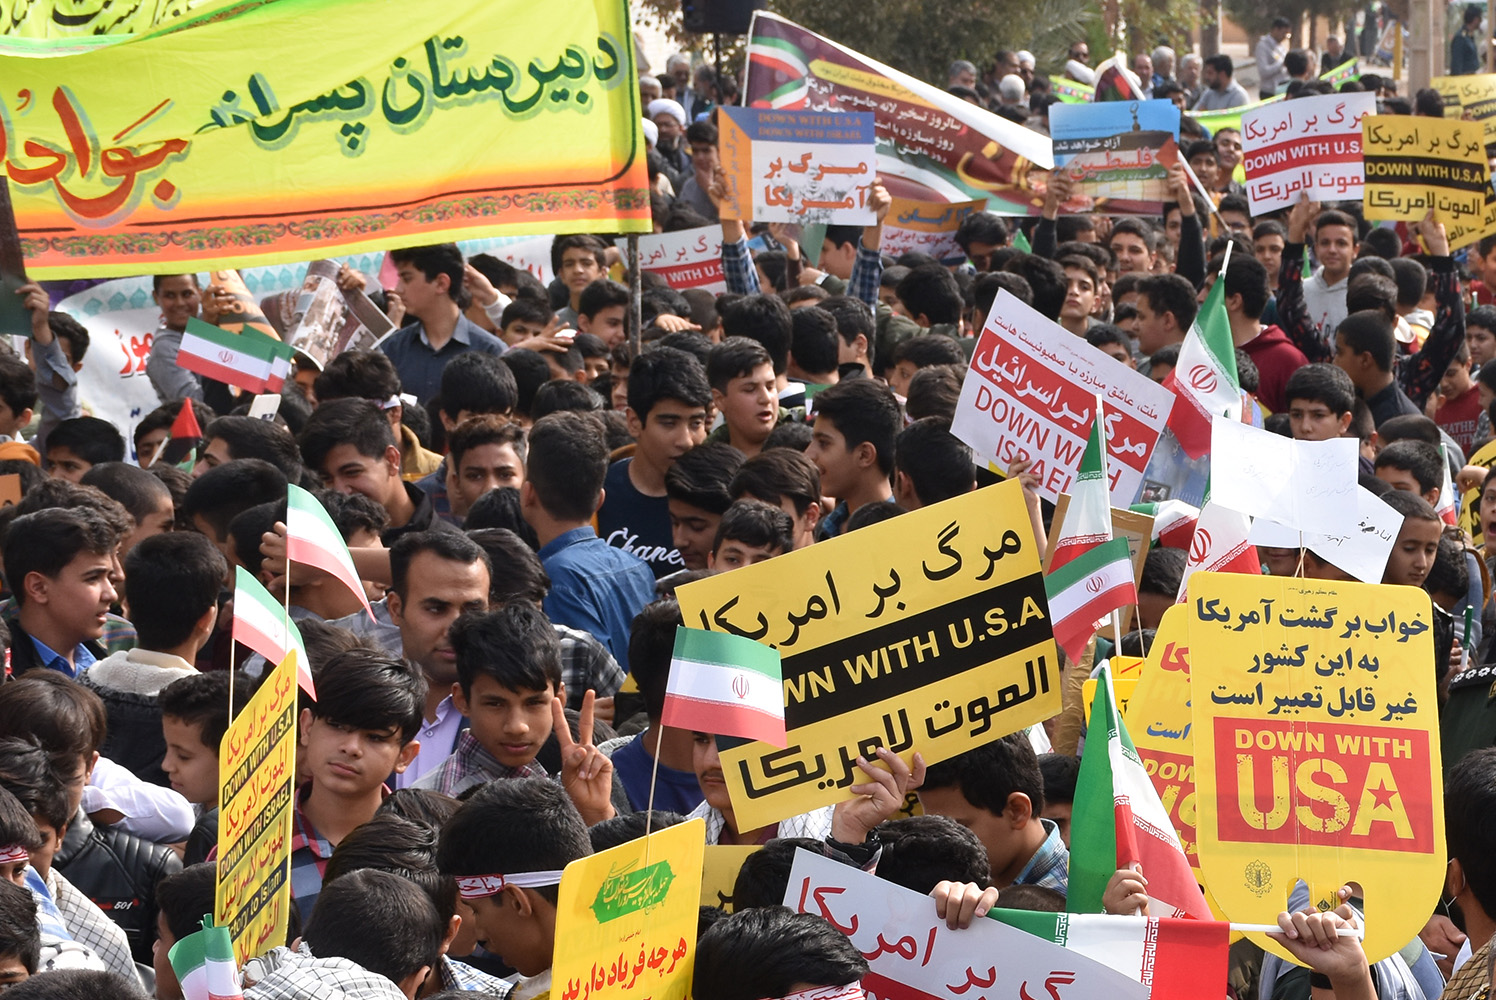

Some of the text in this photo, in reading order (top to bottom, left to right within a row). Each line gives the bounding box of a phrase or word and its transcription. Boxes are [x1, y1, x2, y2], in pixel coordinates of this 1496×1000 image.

[381, 33, 620, 124] دبیرستان
[1244, 111, 1319, 144] بر امریکا
[1367, 125, 1480, 156] مرگ بر امریکا
[764, 152, 868, 181] مرگ بر
[1069, 146, 1153, 181] فلسطین
[1245, 143, 1331, 173] DOWN WITH
[1365, 161, 1412, 177] DOWN
[1415, 166, 1449, 180] WITH
[1438, 198, 1481, 220] الموت
[977, 344, 1062, 407] اسرائیل
[1068, 362, 1078, 374] با
[1079, 371, 1107, 391] مبارزه
[1107, 386, 1134, 406] عاشق
[975, 385, 1050, 451] DOWN
[922, 520, 1022, 580] مرگ
[1196, 596, 1430, 645] خواب آمریکا
[844, 631, 940, 686] WITH
[1247, 643, 1381, 677] به این کشور
[227, 673, 291, 767] مرگ بر امریکا
[1211, 681, 1418, 723] غیر قابل تعبیر است
[1235, 728, 1413, 761] DOWN WITH
[1236, 753, 1416, 841] USA
[249, 872, 283, 917] to Islam
[607, 942, 645, 990] فریاد
[647, 936, 688, 978] هرچه
